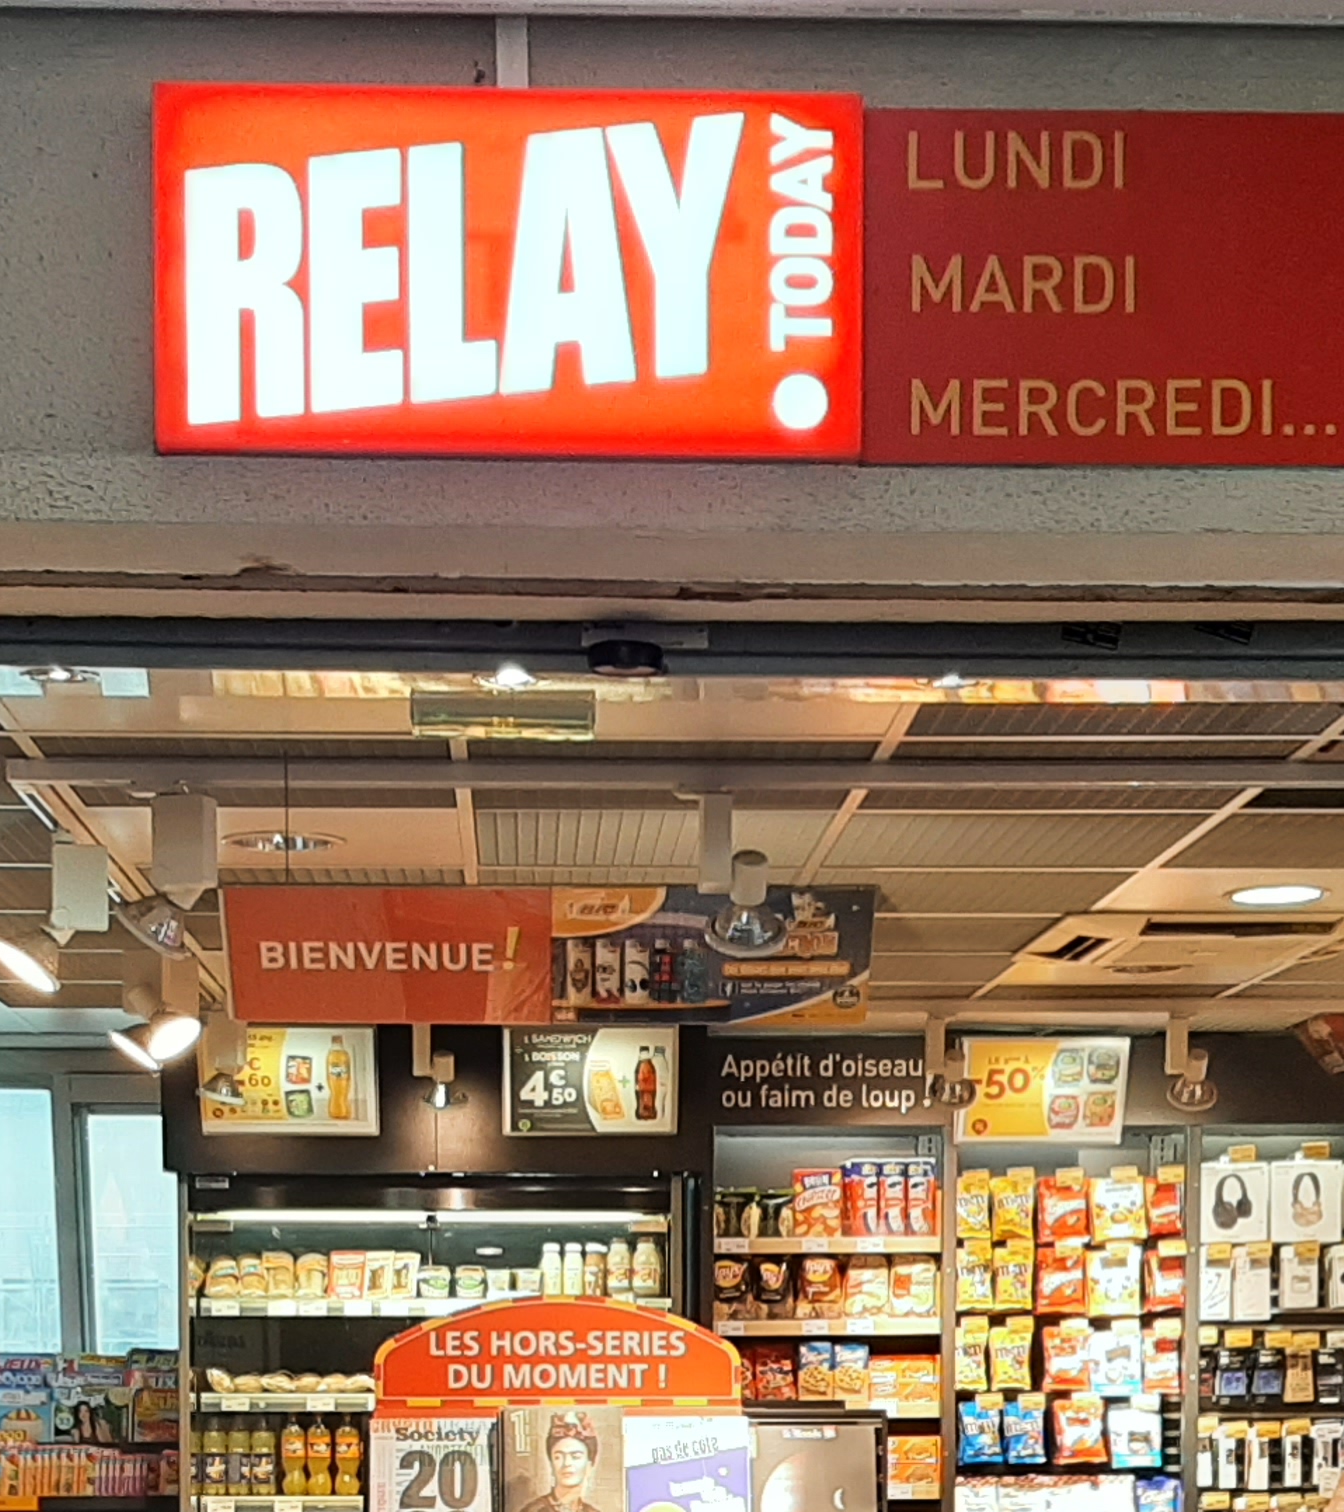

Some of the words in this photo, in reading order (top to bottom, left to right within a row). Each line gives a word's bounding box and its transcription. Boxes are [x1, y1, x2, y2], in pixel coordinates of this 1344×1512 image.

[905, 130, 1127, 193] LUNDI
[768, 112, 835, 351] TODAY
[183, 111, 745, 428] RELAY
[909, 253, 1138, 315] MARDI
[908, 377, 1340, 440] MERCREDI...
[258, 940, 496, 972] BIENVENUE
[721, 1053, 812, 1084] Appétit
[819, 1052, 924, 1079] d'oiseau
[721, 1089, 752, 1108] ou
[759, 1084, 816, 1109] faim
[823, 1084, 854, 1109] de
[861, 1085, 916, 1115] loup
[428, 1331, 481, 1358] LES
[490, 1329, 686, 1357] HORS-SERIES
[447, 1364, 492, 1391] DU
[502, 1362, 649, 1390] MOMENT
[395, 1426, 480, 1447] Society
[399, 1449, 479, 1510] 20
